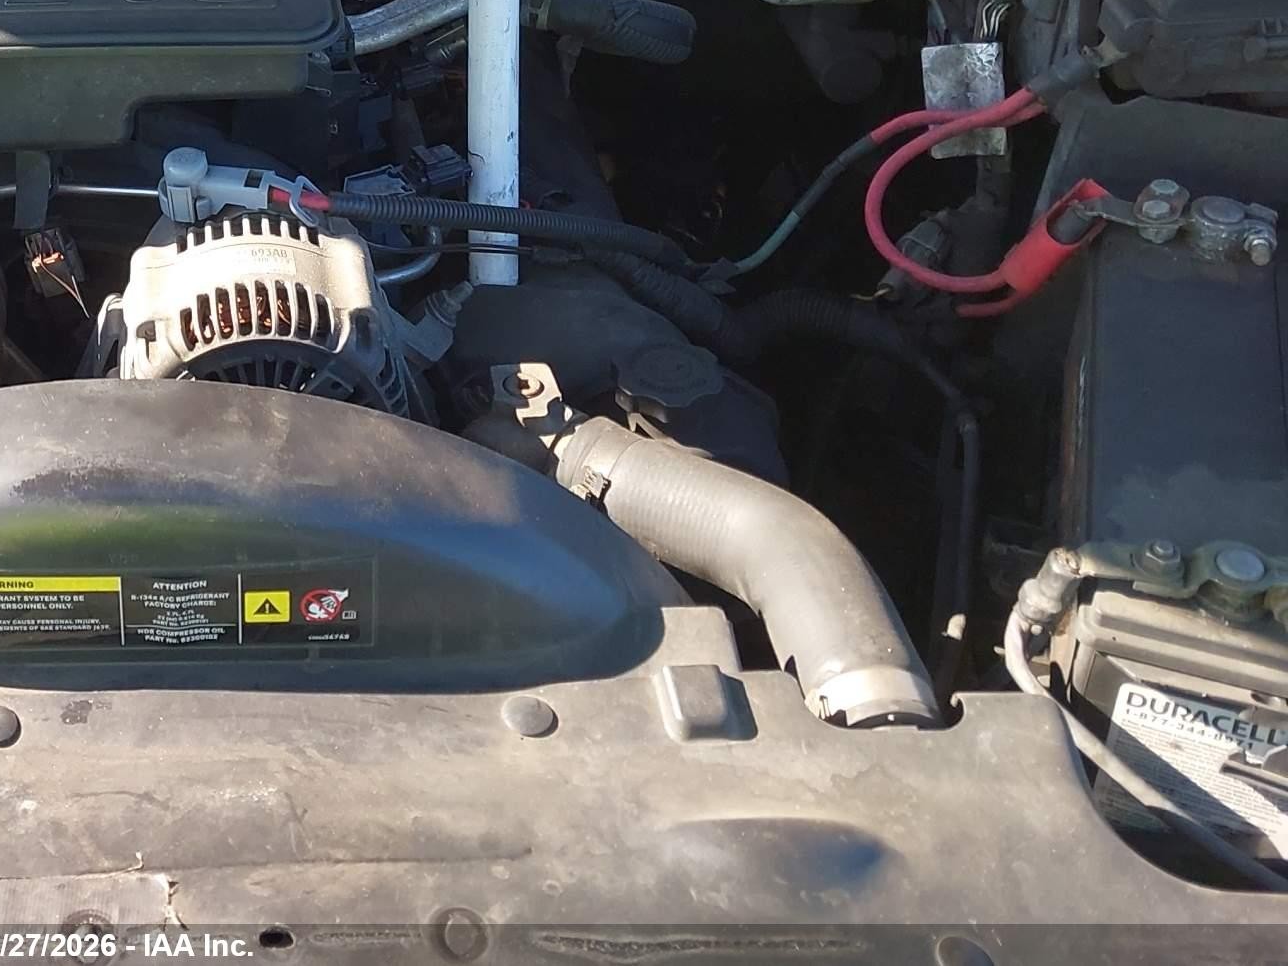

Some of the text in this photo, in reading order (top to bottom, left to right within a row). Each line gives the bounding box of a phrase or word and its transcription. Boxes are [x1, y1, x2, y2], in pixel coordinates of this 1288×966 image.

[153, 580, 207, 591] ATTENTION
[175, 592, 230, 603] REFRIGERANT
[144, 601, 180, 609] FACTORY
[156, 628, 210, 637] COMPRESSOR
[144, 634, 165, 642] PART
[1126, 692, 1281, 747] DURACELL
